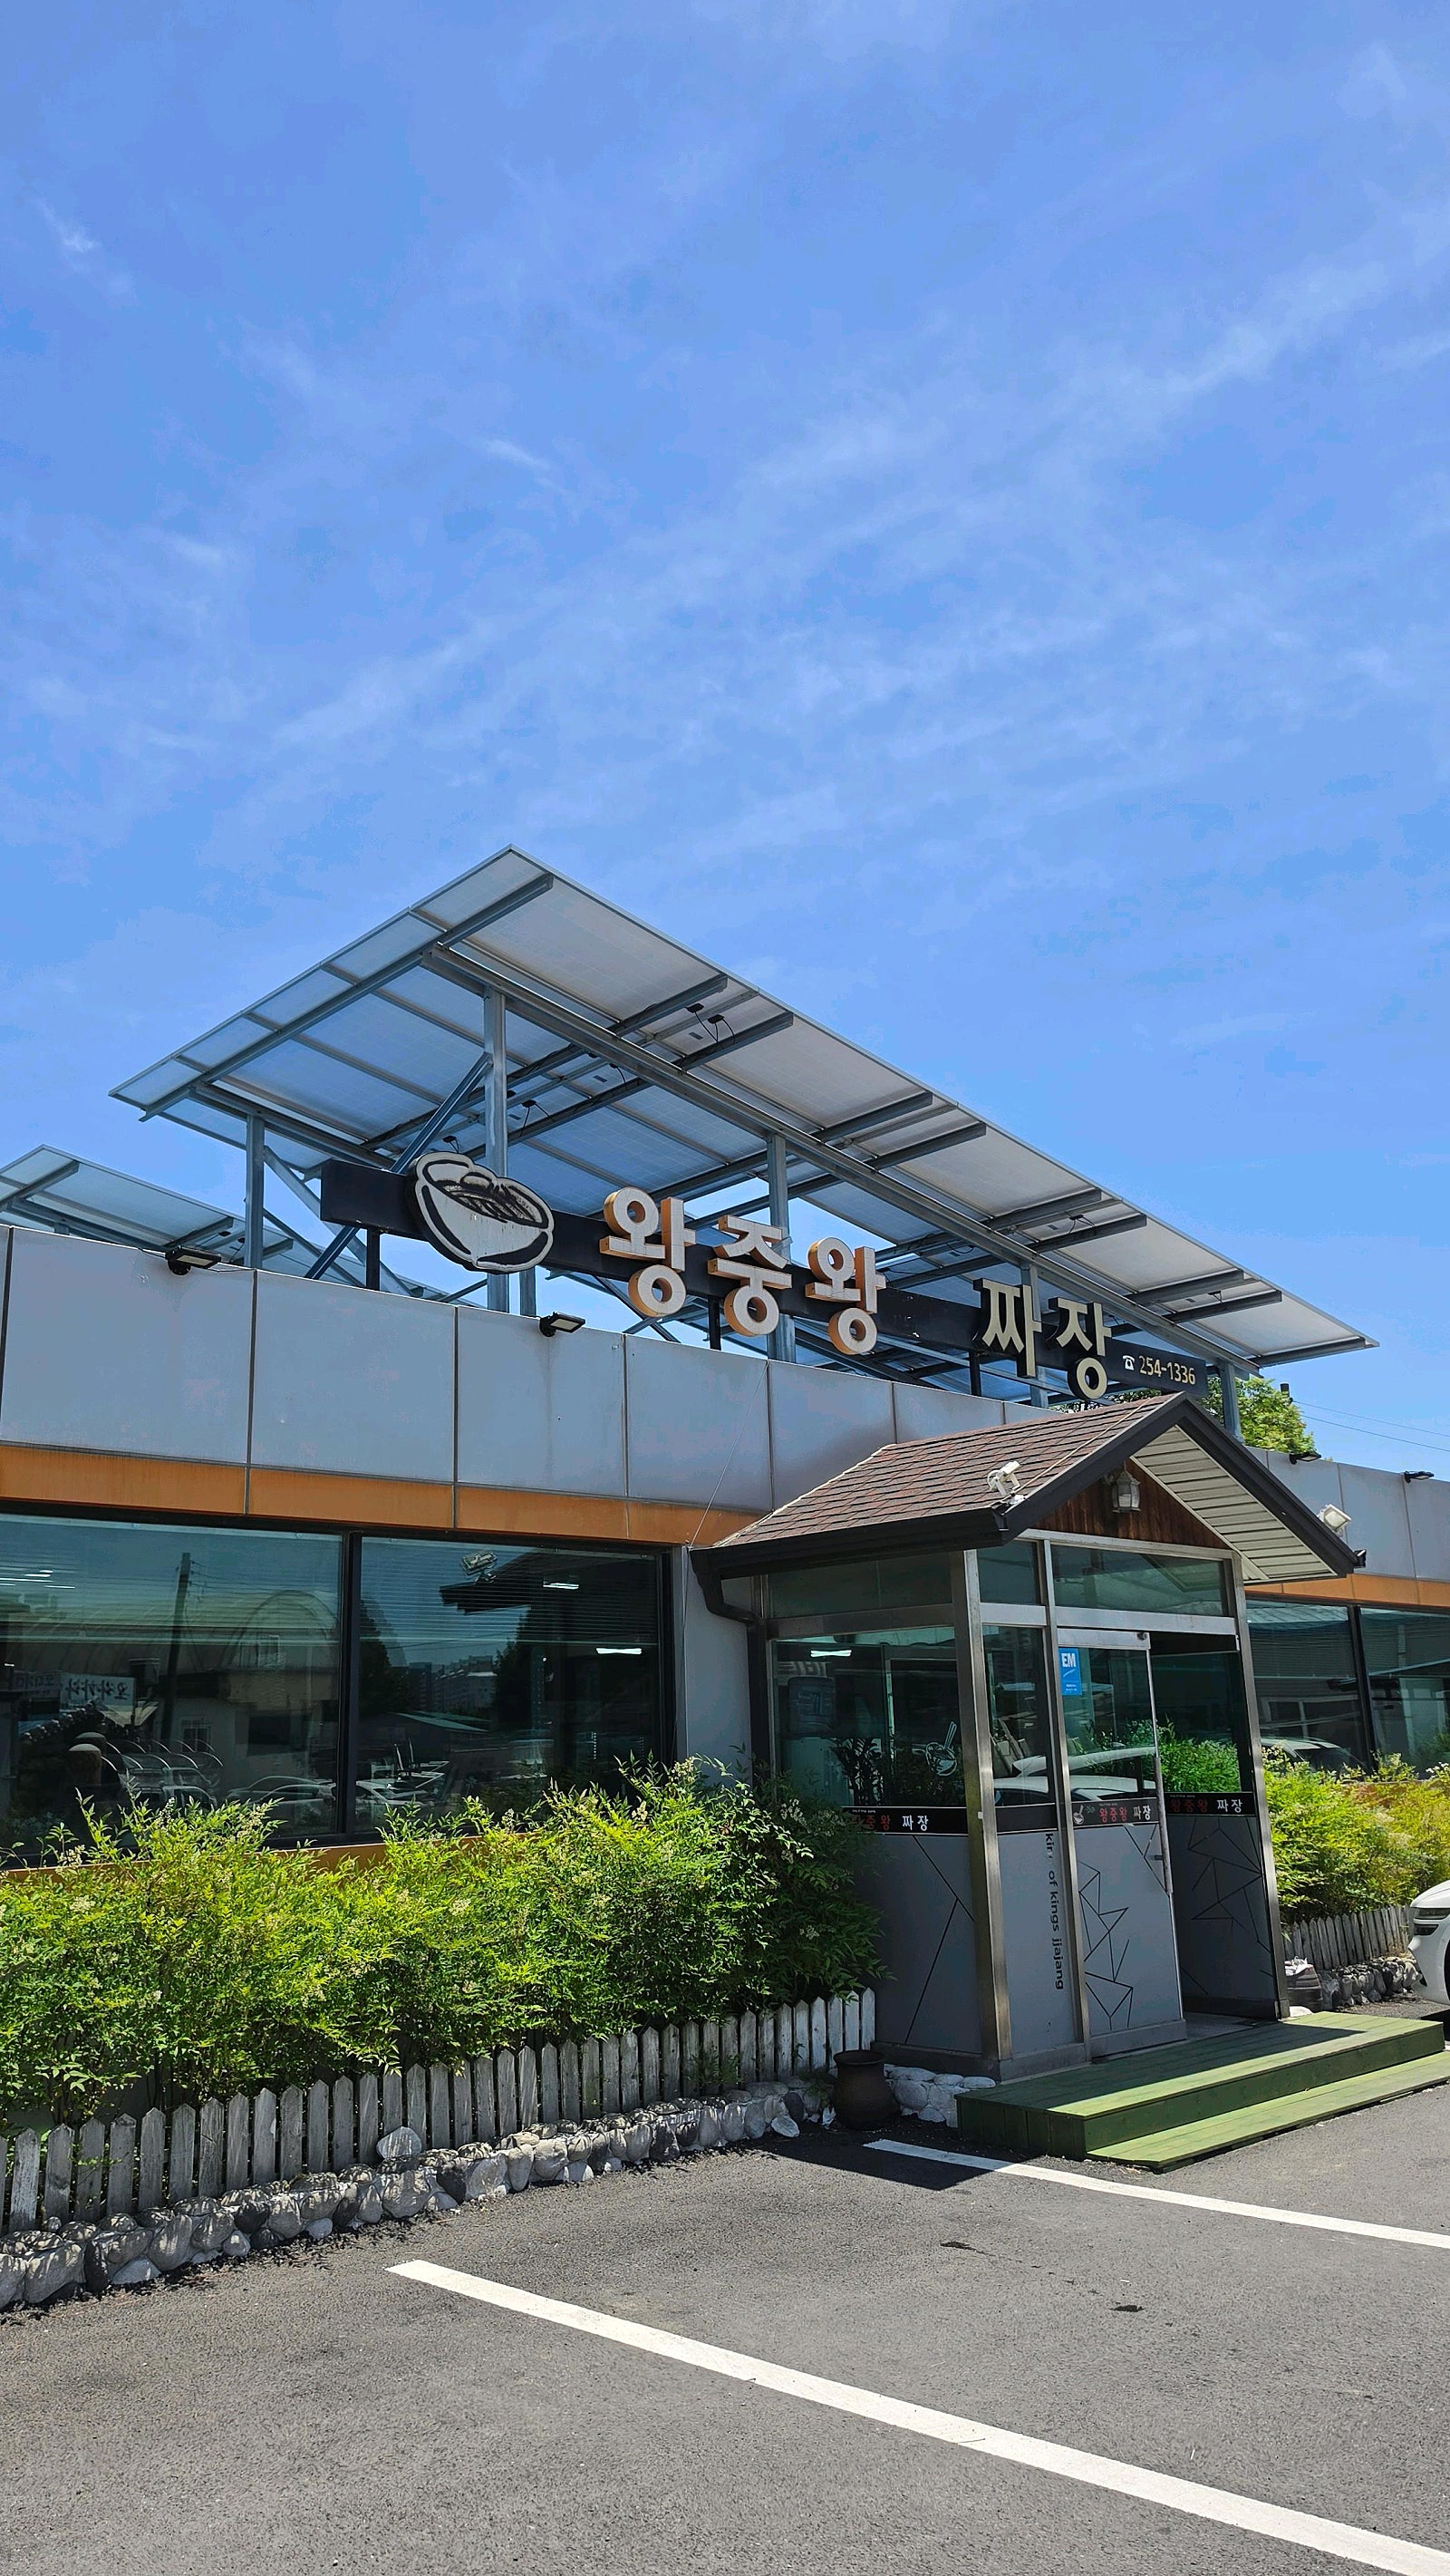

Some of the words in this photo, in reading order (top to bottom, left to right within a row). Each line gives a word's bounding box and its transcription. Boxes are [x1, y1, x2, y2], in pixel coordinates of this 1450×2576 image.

[599, 1186, 887, 1356] 왕중왕
[973, 1277, 1113, 1401] 짜장
[1138, 1355, 1196, 1385] 254-1336
[1060, 1652, 1077, 1668] EM
[902, 1815, 929, 1831] 짜장
[1099, 1806, 1127, 1824] 왕중왕
[1133, 1805, 1151, 1821] 짜장
[1045, 1833, 1055, 1864] kin
[1048, 1870, 1058, 1886] of
[1049, 1891, 1059, 1932] kings
